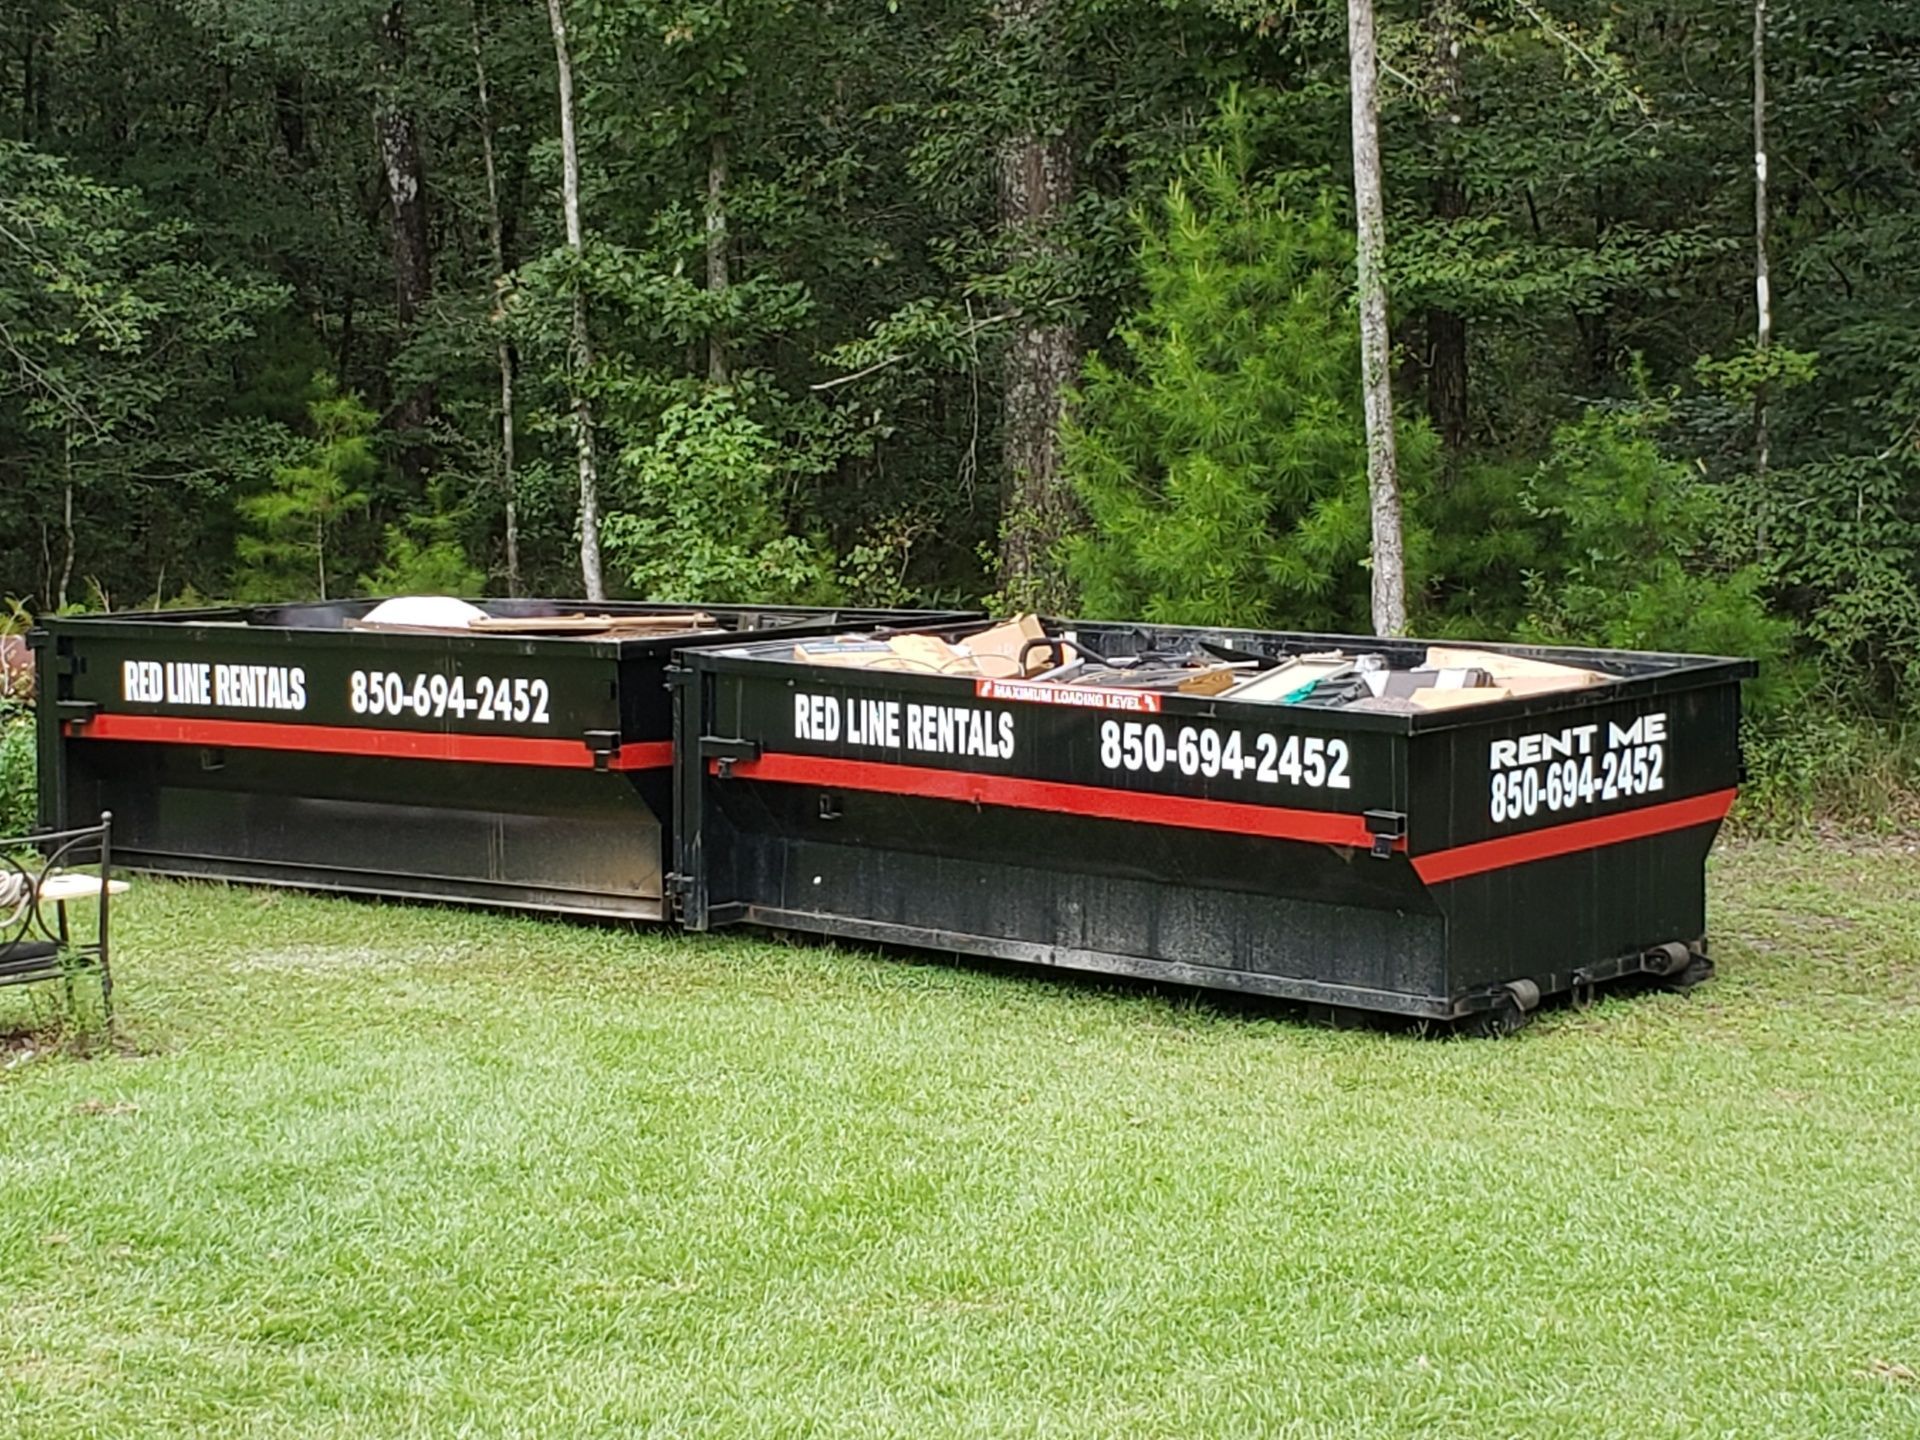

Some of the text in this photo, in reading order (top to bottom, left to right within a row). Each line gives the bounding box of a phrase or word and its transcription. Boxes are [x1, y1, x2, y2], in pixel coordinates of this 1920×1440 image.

[123, 660, 306, 711] RED LINE RENTALS
[350, 670, 550, 724] 850-694-2452
[994, 685, 1142, 710] MAXIMUM LOADING LEVEL
[794, 693, 1015, 760] RED LINE RENTALS
[1100, 719, 1351, 790] 850-694-2452
[1490, 712, 1667, 770] RENT ME
[1490, 743, 1664, 823] 850-694-2452
